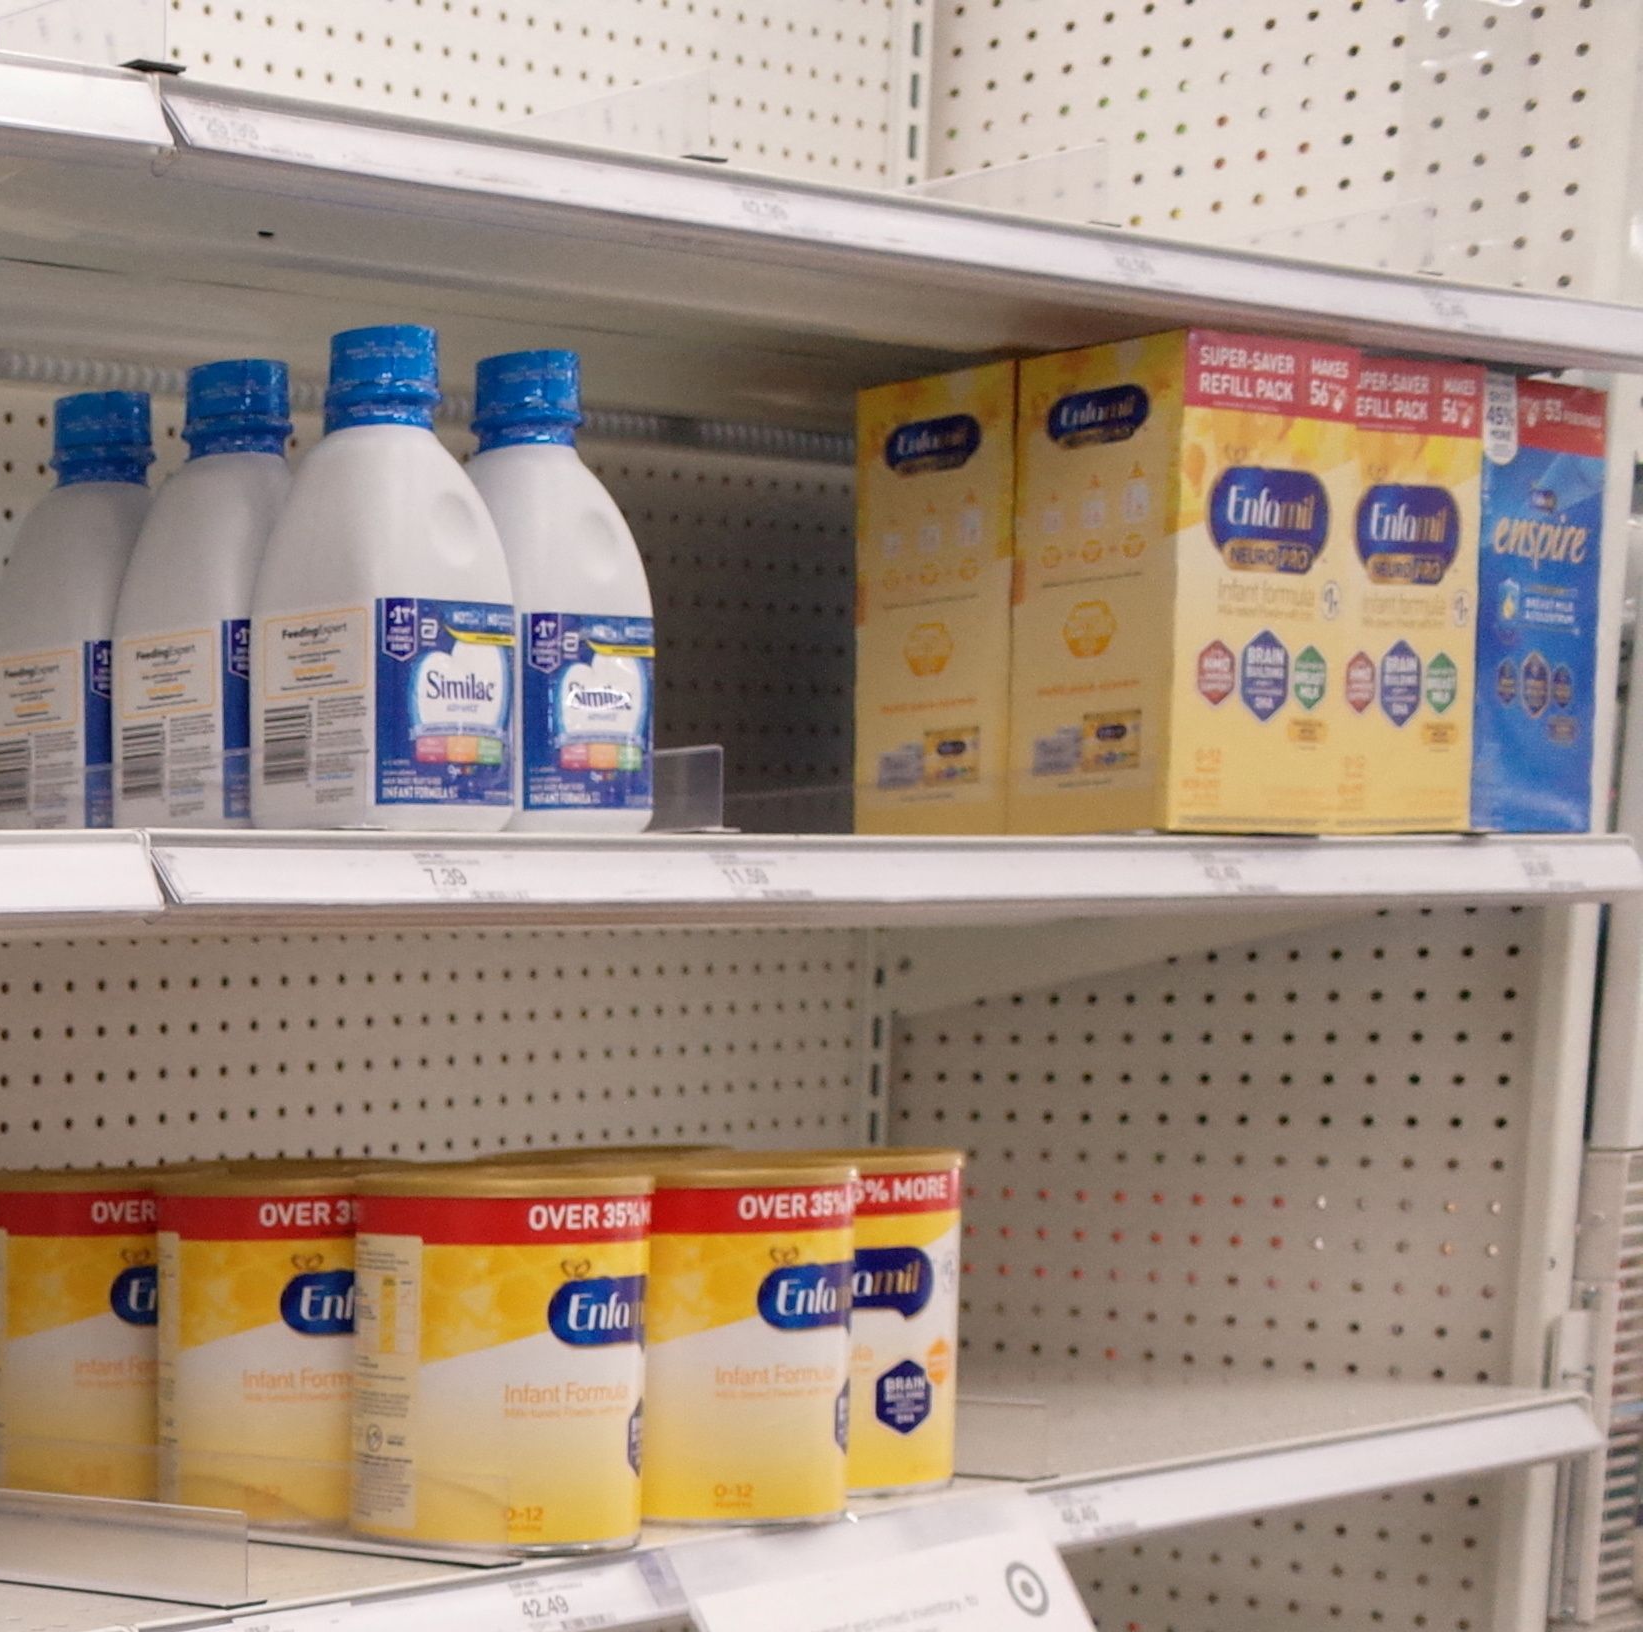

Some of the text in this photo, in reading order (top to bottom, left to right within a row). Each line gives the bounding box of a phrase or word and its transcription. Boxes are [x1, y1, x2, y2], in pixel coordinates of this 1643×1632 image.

[1199, 346, 1349, 379] SUPER-SAVER MAKES
[1199, 373, 1328, 406] REFILL PACK 56
[1357, 371, 1476, 397] PER-SAVER MAKES
[1355, 396, 1458, 424] EFILL PACK 56
[1487, 406, 1514, 426] 45%
[1227, 483, 1315, 531] Enfamil
[1370, 501, 1447, 543] Enfamil
[1493, 514, 1589, 571] enspire
[1217, 579, 1315, 606] Infant formula
[1361, 591, 1447, 617] Infant formula
[282, 623, 348, 640] FeedingExpert
[1246, 646, 1285, 664] BRAIN
[1386, 656, 1418, 672] BRAIN
[426, 670, 494, 702] Similac
[382, 786, 413, 800] INFANT
[422, 868, 468, 886] 7.39
[893, 1175, 948, 1201] MORE
[91, 1202, 155, 1225] OVER
[259, 1202, 330, 1229] OVER
[528, 1202, 640, 1231] OVER 35%
[738, 1192, 847, 1220] OVER 35%
[853, 1264, 921, 1298] amil
[776, 1277, 848, 1317] Enfa
[568, 1291, 640, 1332] Enfa
[75, 1357, 125, 1377] Infant
[243, 1368, 356, 1391] Infant Form
[716, 1365, 837, 1386] Infant Formula
[504, 1381, 629, 1406] Infant Formula
[884, 1377, 926, 1393] BRAIN
[715, 1484, 753, 1498] 0-12
[503, 1507, 544, 1524] 0-12
[522, 1595, 570, 1619] 42.49
